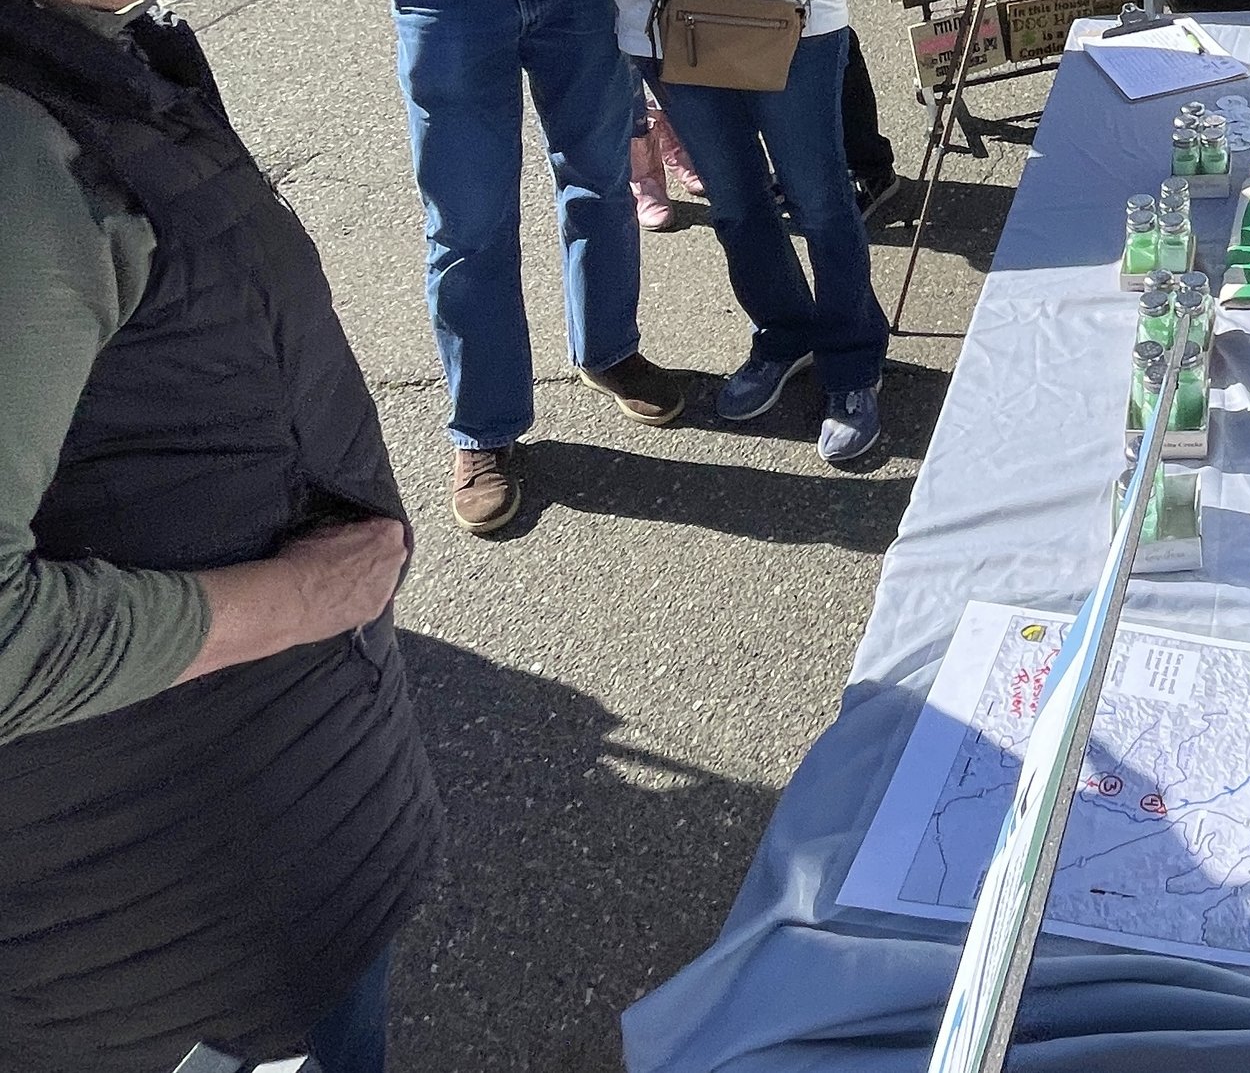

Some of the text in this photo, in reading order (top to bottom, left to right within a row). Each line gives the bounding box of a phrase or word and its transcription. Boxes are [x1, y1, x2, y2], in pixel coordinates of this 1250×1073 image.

[1019, 42, 1064, 58] Condi
[1009, 668, 1030, 720] River
[1028, 665, 1051, 719] Russia
[1103, 779, 1118, 793] 3
[1144, 796, 1160, 809] 4
